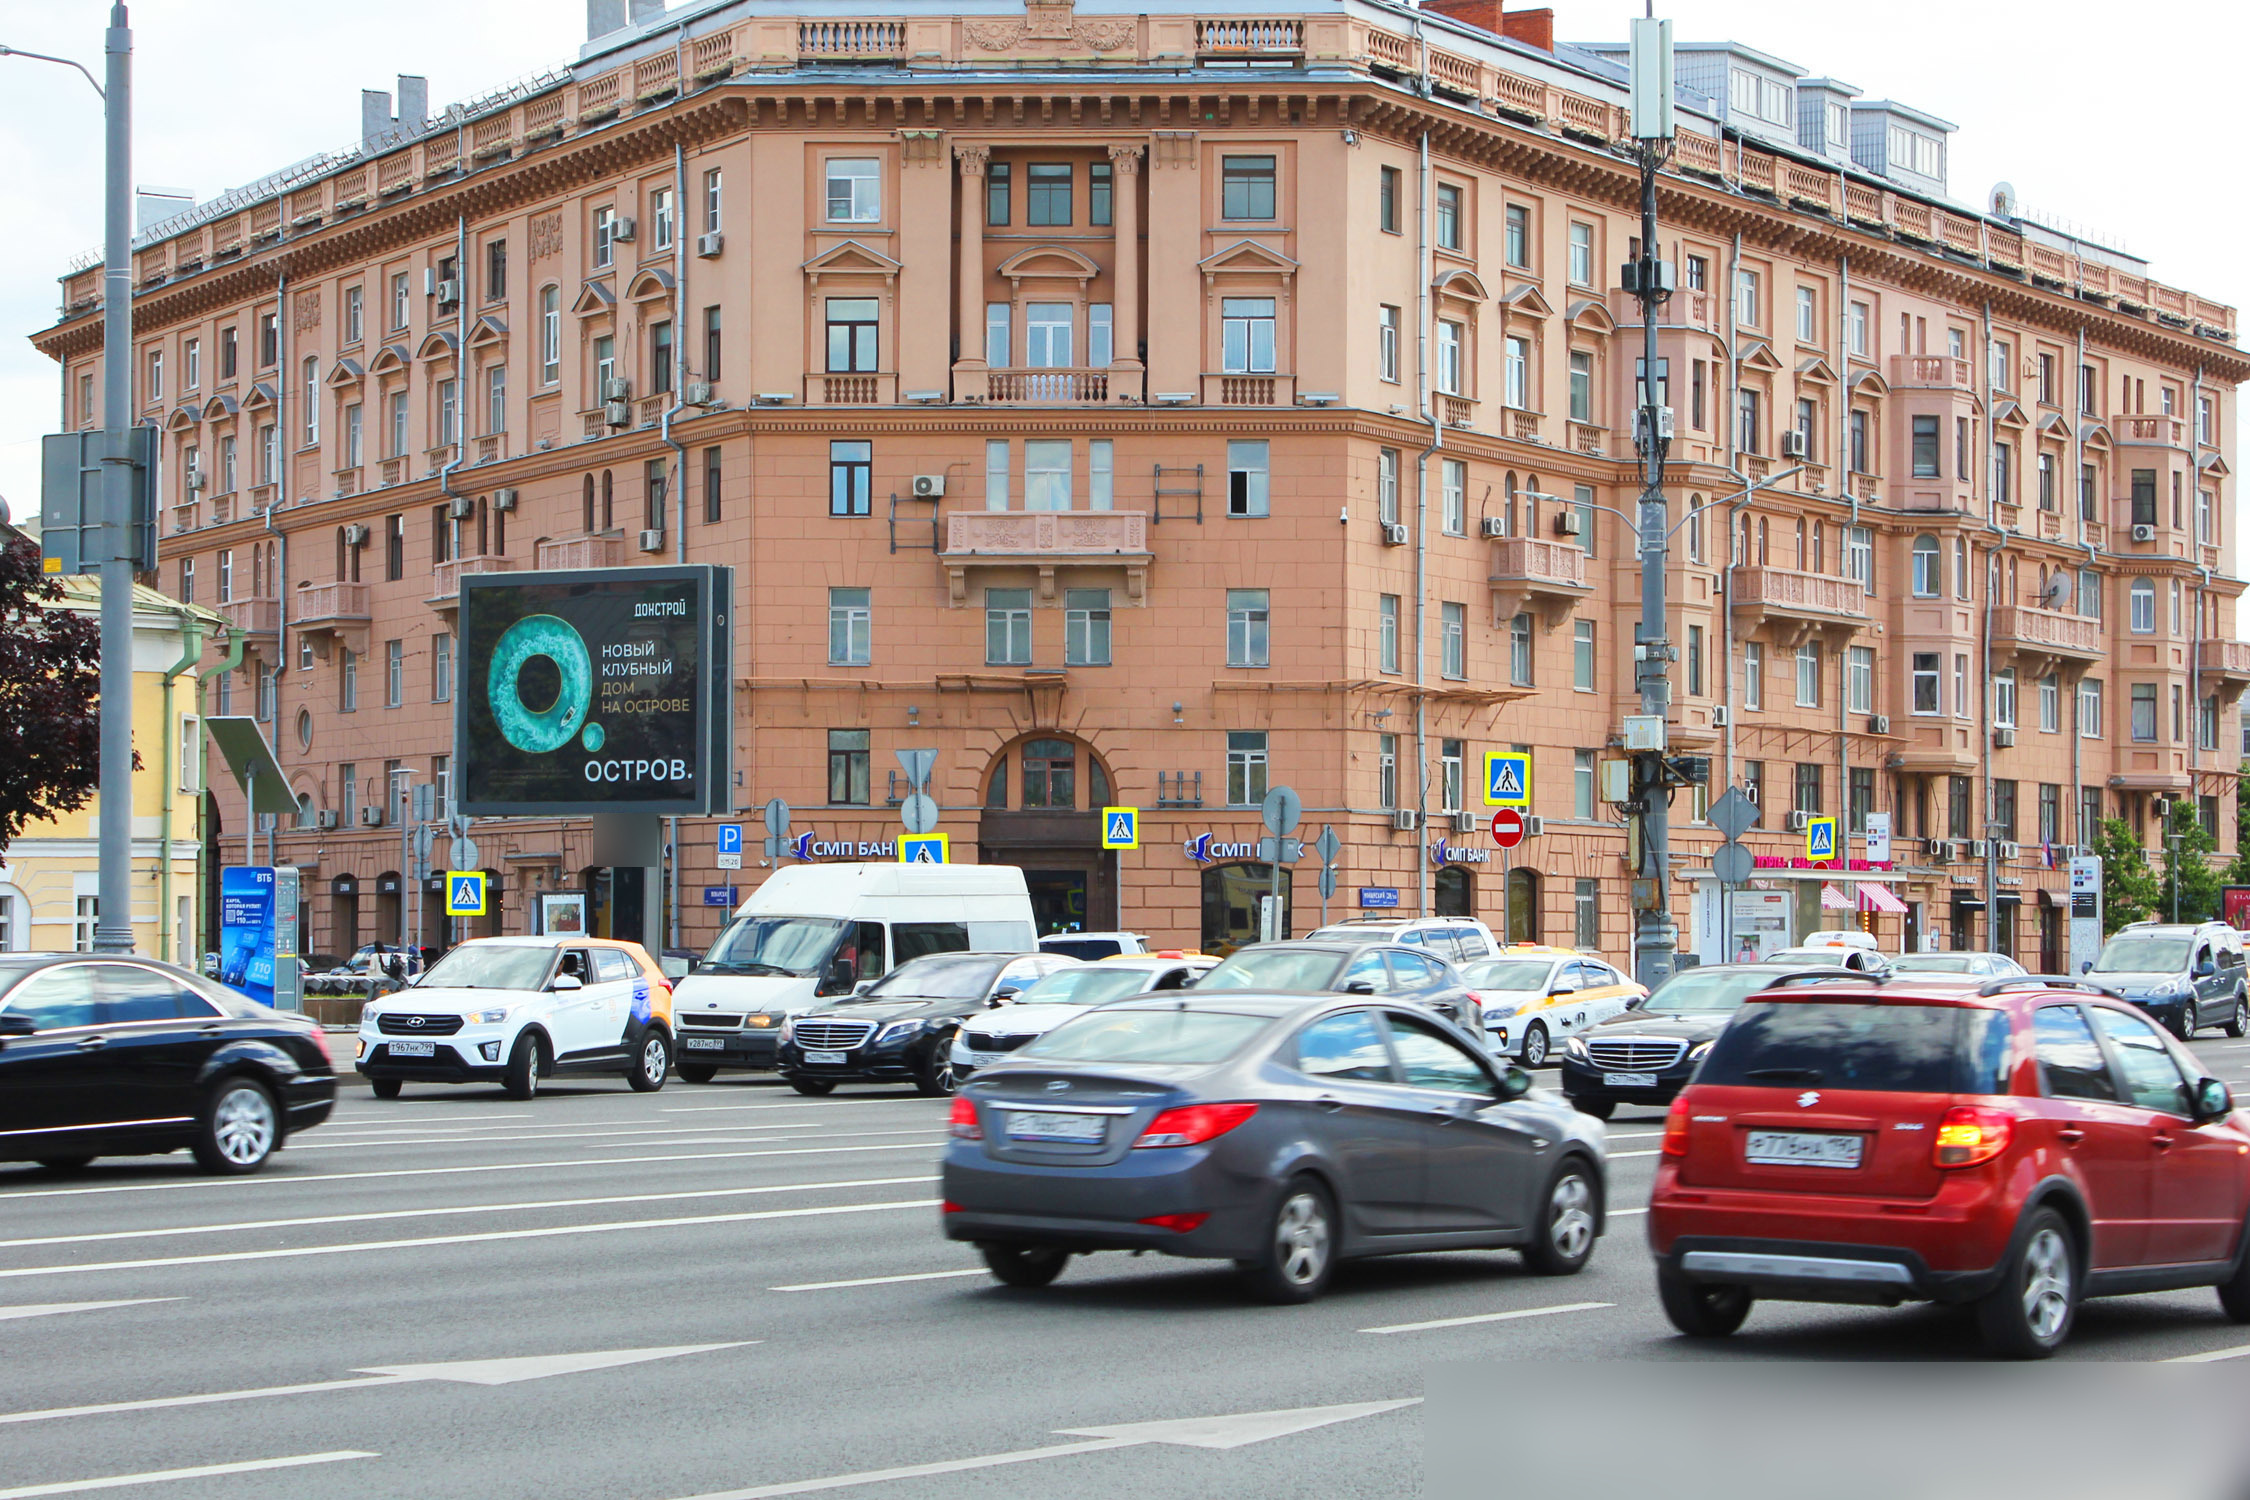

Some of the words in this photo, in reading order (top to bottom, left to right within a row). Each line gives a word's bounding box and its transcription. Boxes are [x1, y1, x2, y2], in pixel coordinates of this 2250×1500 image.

[634, 599, 686, 617] ДОНСТРОЙ
[602, 640, 655, 658] НОВЫЙ
[602, 659, 672, 676] КЛУБНЫЙ
[601, 682, 635, 697] ДОМ
[602, 700, 621, 713] НА
[624, 698, 690, 713] ОСТРОВЕ
[584, 758, 693, 782] ОСТРОВ.
[724, 827, 738, 851] P
[812, 841, 853, 856] СМП
[1210, 843, 1251, 858] СМП
[1445, 848, 1466, 861] СМП
[1467, 848, 1491, 862] БАНК
[257, 873, 272, 883] ВТБ
[254, 962, 271, 974] 110
